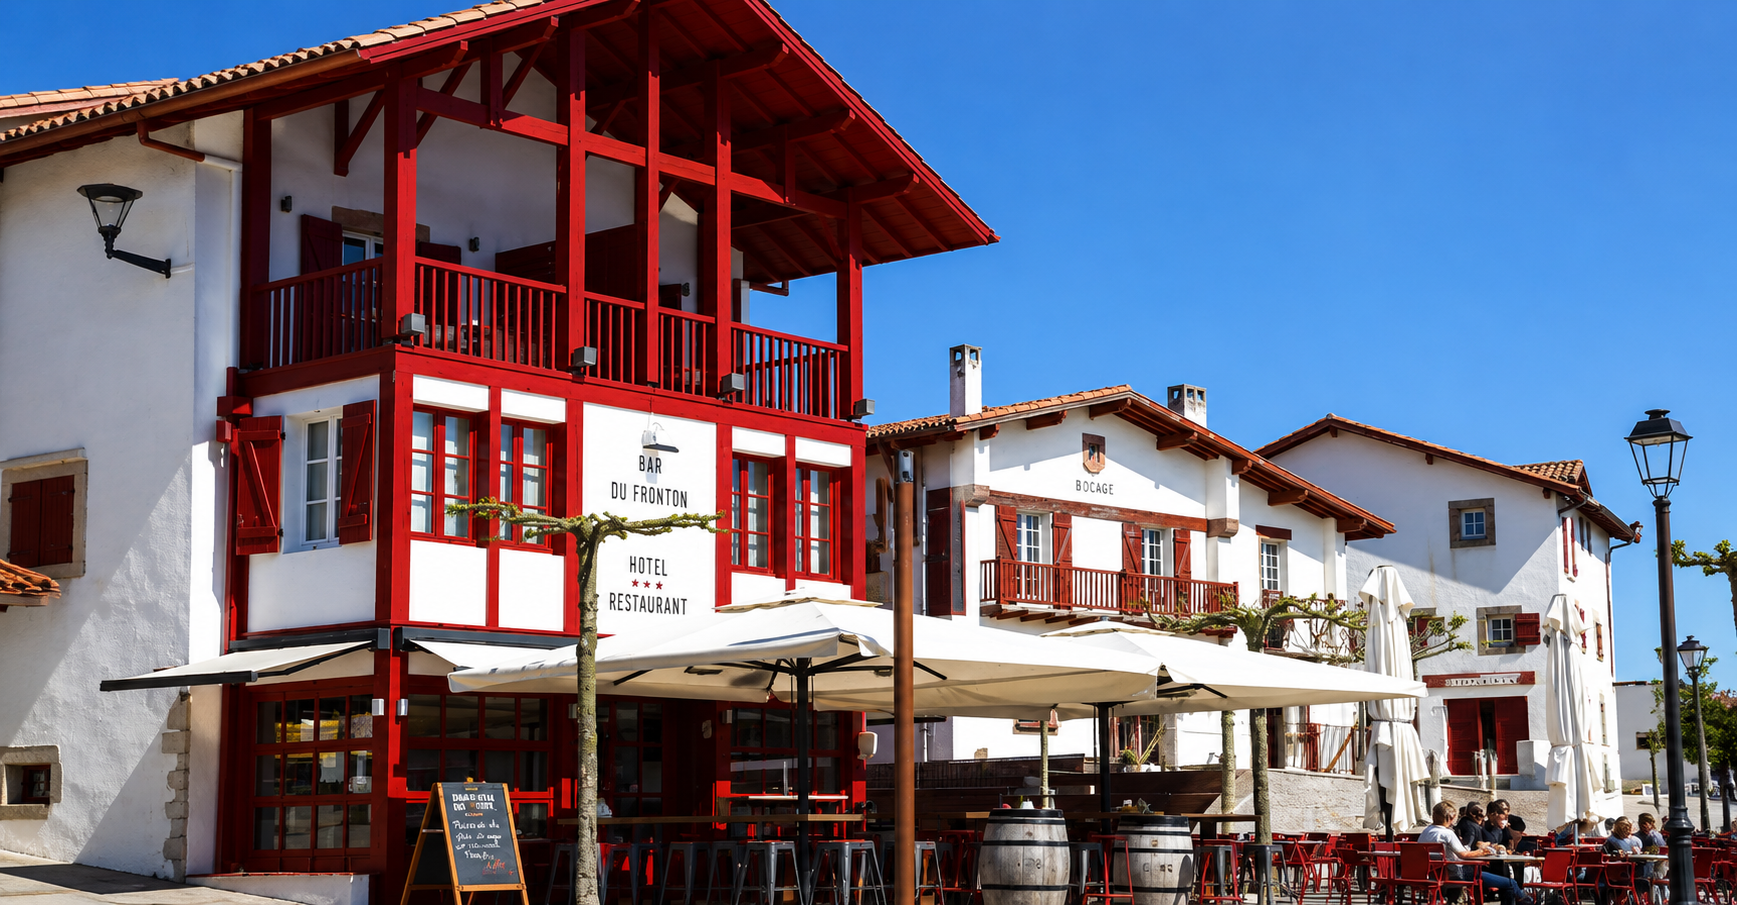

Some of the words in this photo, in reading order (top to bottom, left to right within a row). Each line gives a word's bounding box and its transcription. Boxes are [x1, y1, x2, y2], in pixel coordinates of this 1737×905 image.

[639, 455, 662, 474] BAR
[611, 482, 627, 501] DU
[633, 485, 688, 509] FRONTON
[1076, 479, 1114, 495] BOCAGE
[629, 556, 668, 577] HOTEL
[609, 592, 688, 615] RESTAURANT
